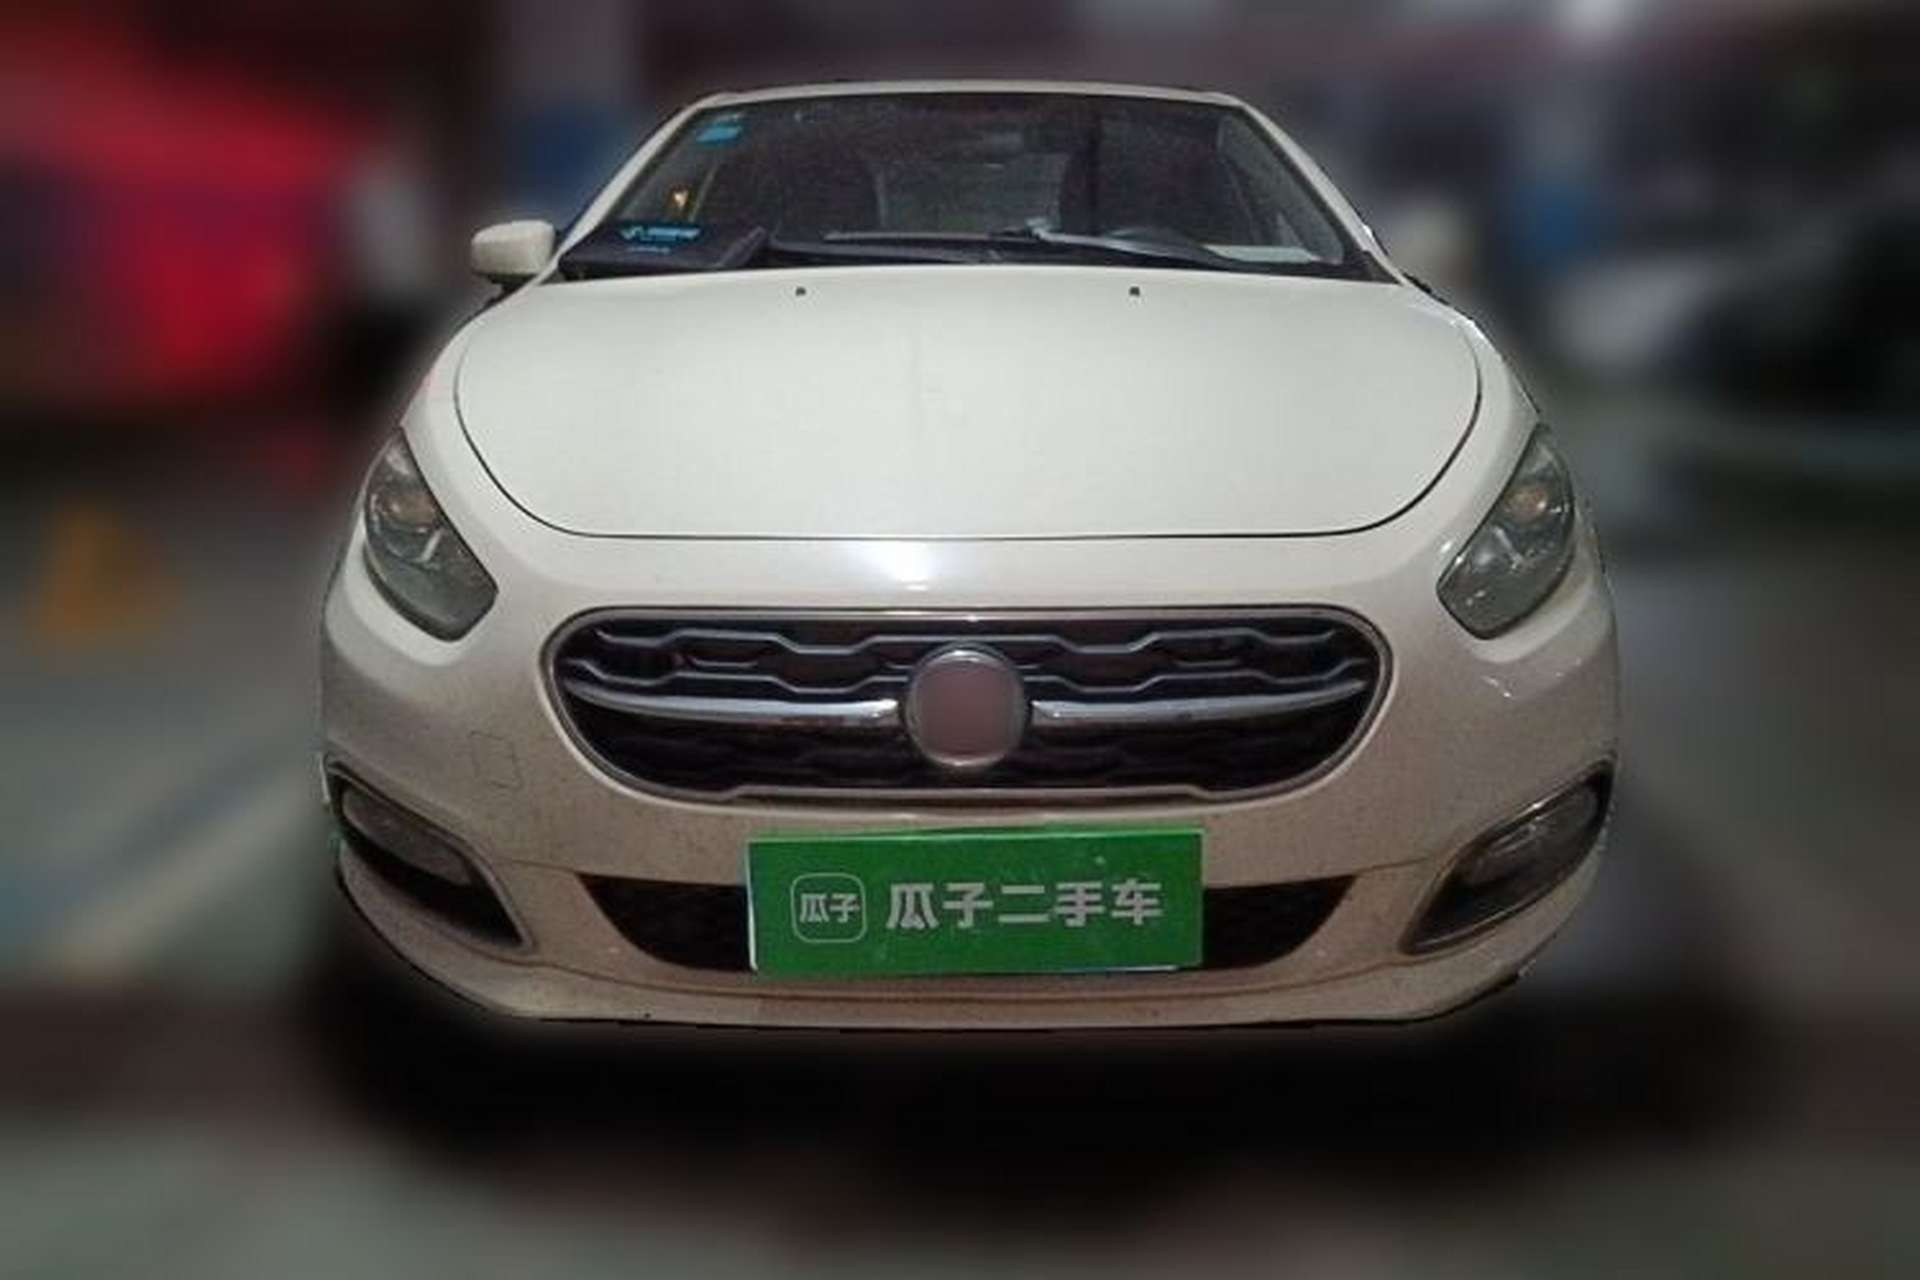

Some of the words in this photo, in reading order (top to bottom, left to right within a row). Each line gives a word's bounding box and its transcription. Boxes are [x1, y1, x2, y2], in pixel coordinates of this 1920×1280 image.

[800, 893, 860, 923] 瓜子
[886, 879, 1163, 930] 瓜子二手车
